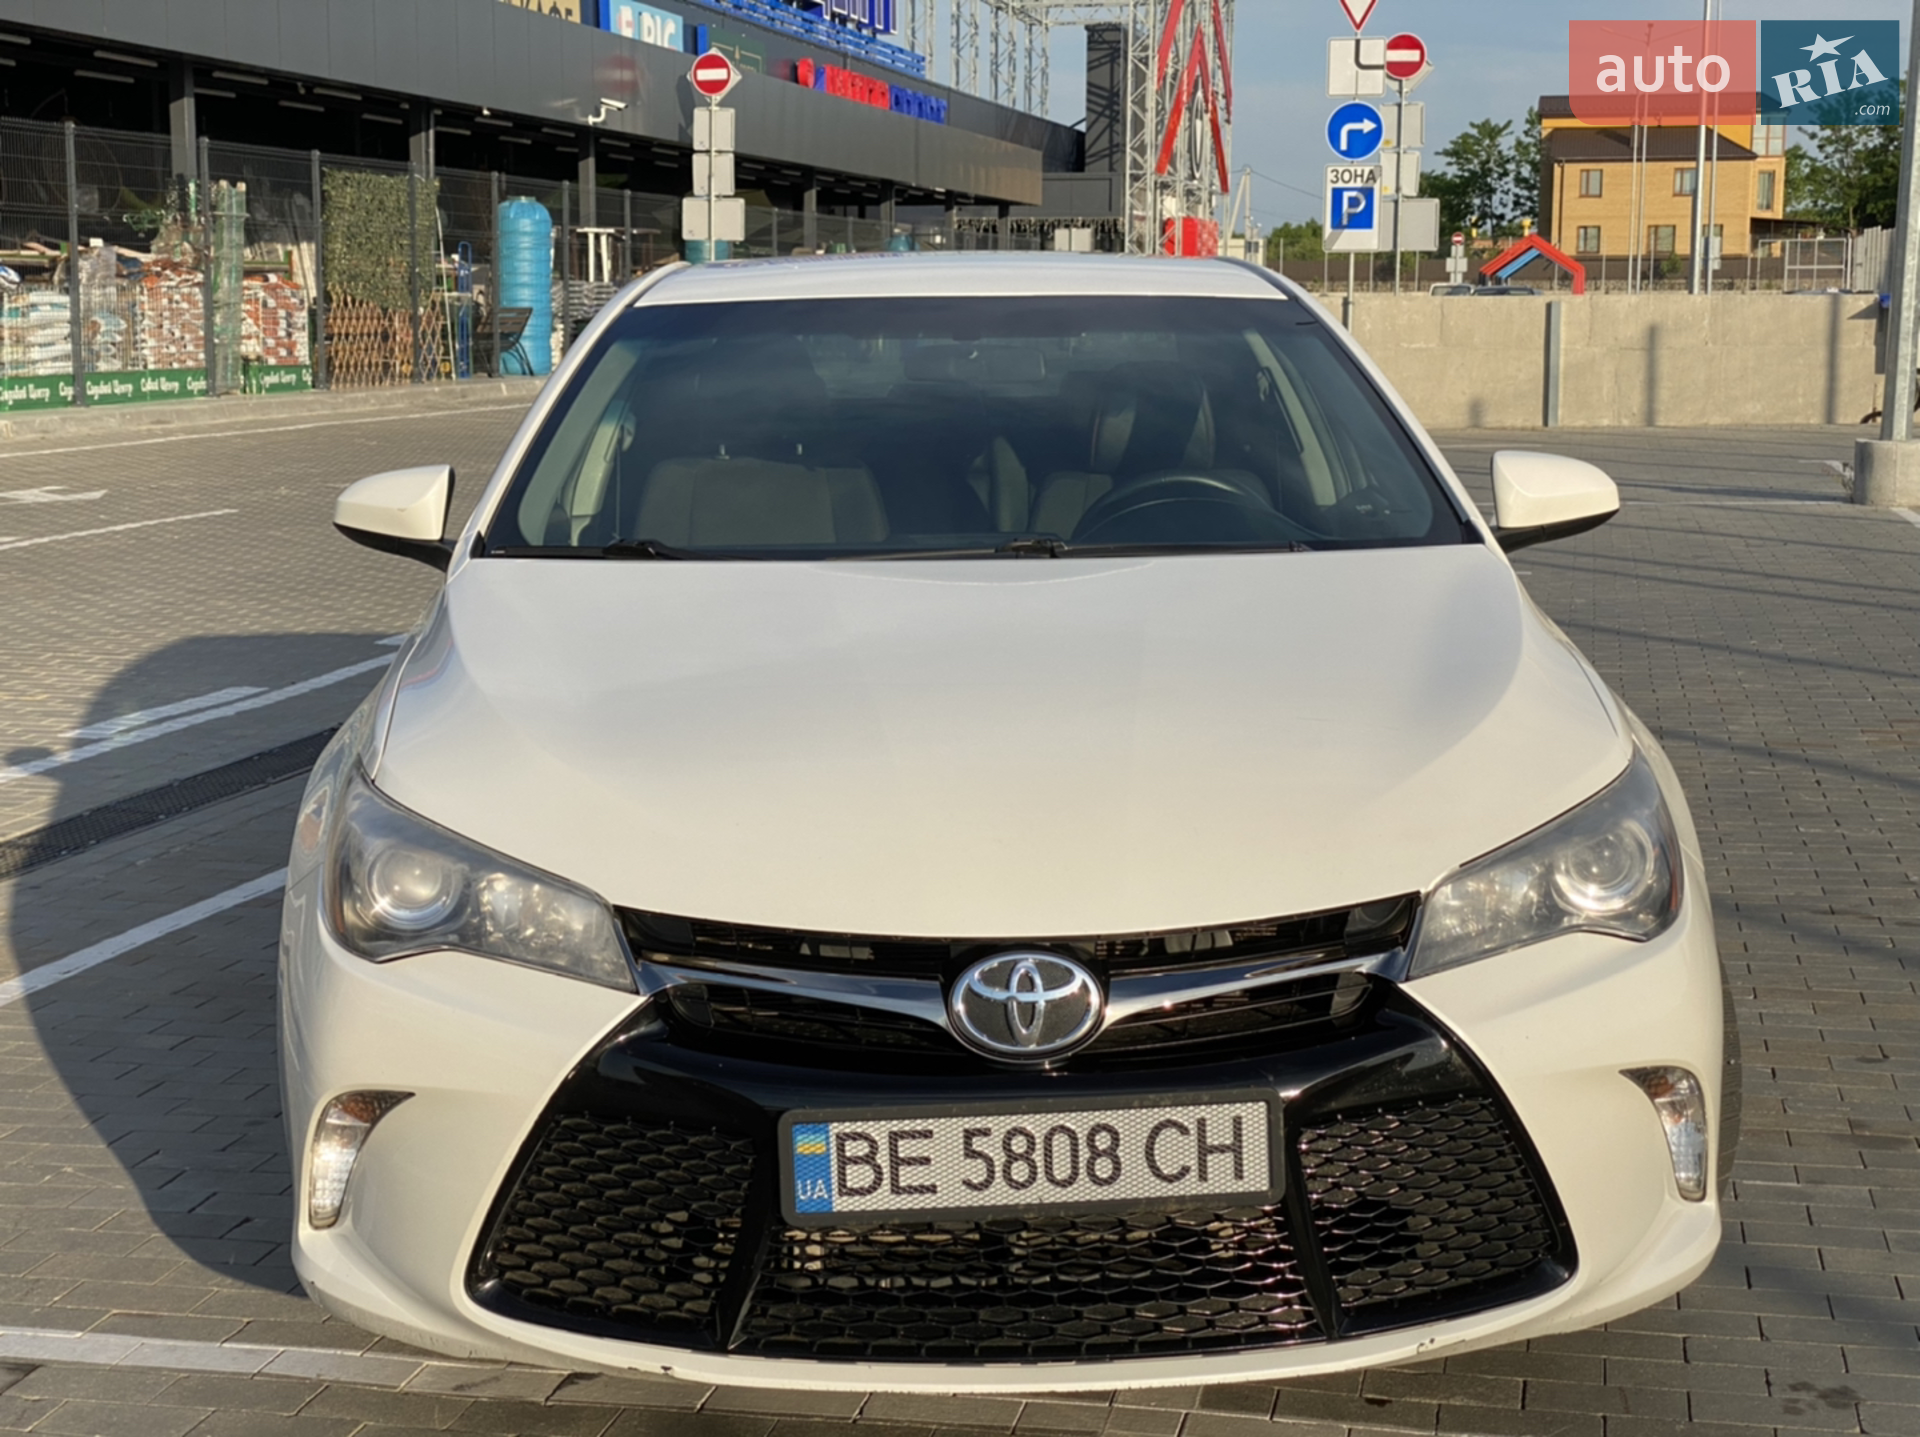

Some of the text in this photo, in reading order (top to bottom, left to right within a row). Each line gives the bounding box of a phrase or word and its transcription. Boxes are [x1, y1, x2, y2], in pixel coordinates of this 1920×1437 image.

[1330, 168, 1377, 184] ЗОНА
[1342, 190, 1366, 226] P
[836, 1115, 1244, 1197] BE 5808 CH
[796, 1178, 829, 1201] UA
